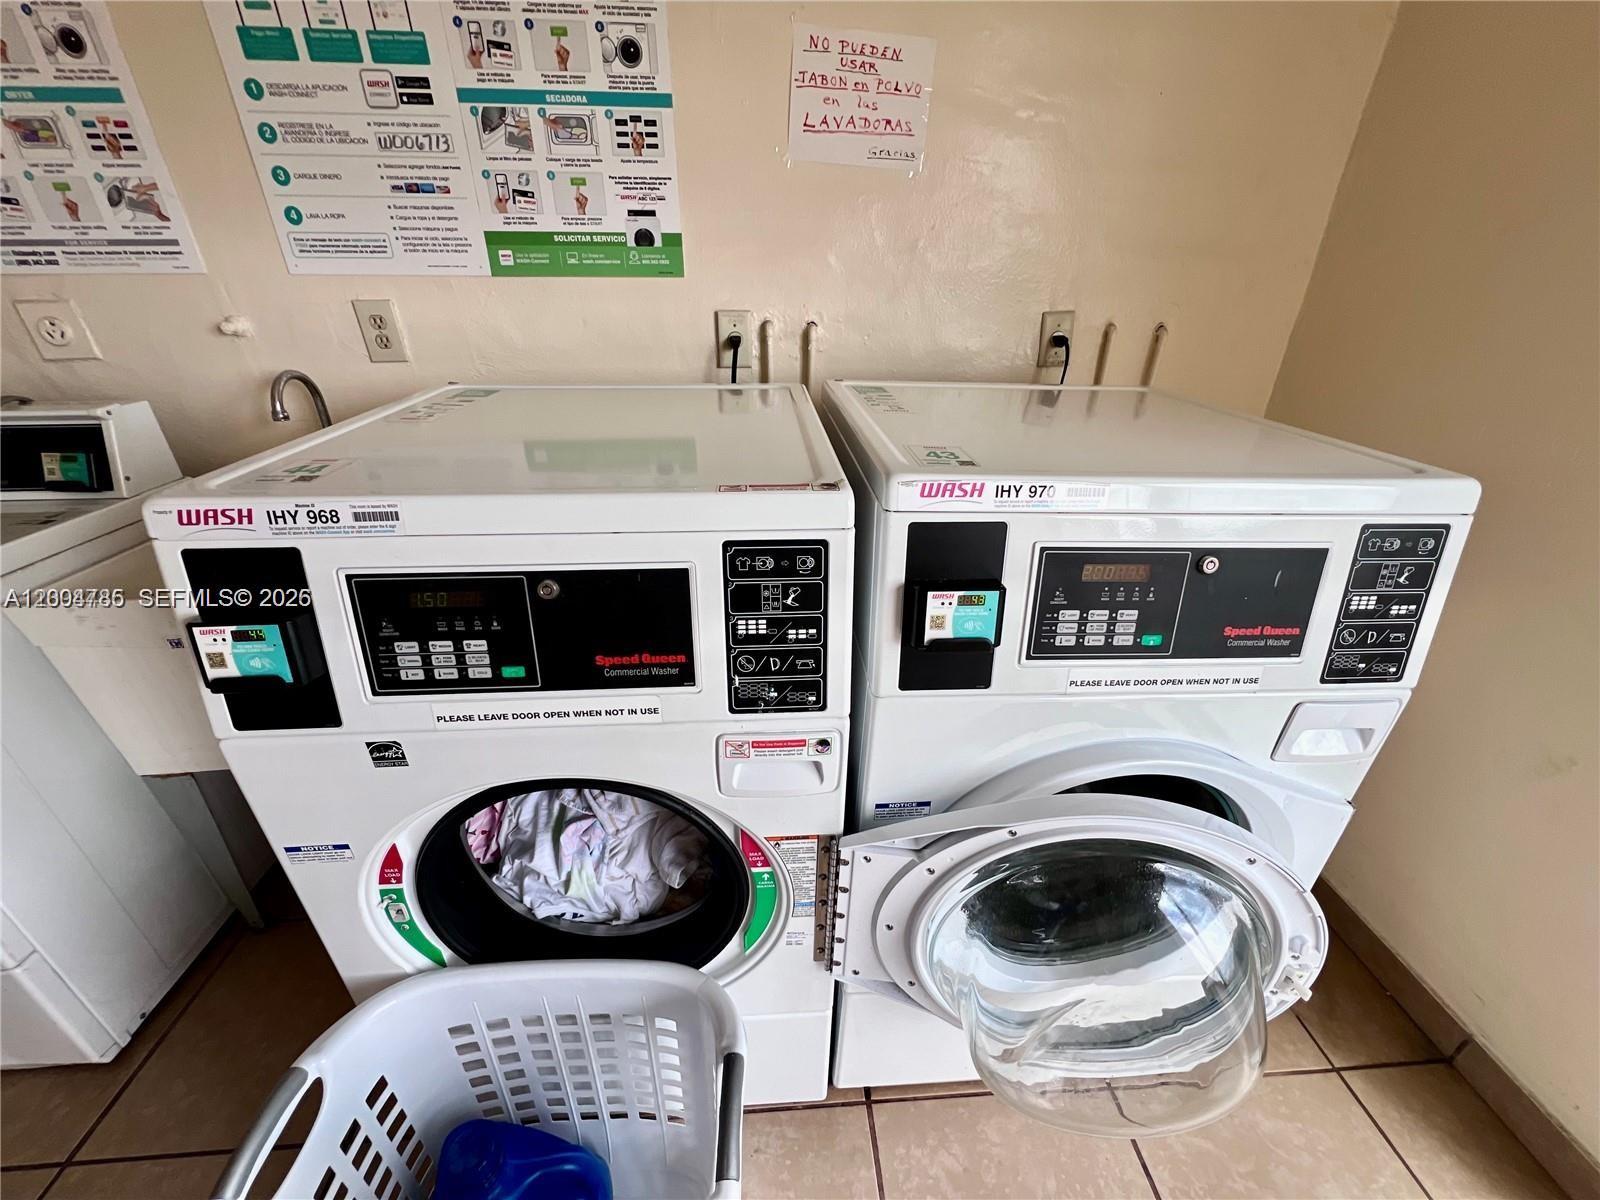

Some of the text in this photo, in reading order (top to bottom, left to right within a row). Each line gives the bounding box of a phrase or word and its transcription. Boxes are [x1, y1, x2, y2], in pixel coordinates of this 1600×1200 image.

[810, 34, 902, 60] NO PUEDEN
[840, 57, 879, 73] USAR
[366, 80, 390, 89] WASH
[795, 71, 922, 94] JABON en POLVO
[545, 93, 588, 104] SECADORA
[823, 96, 840, 107] en
[803, 112, 913, 133] LAVADORAS
[263, 126, 272, 139] 2
[277, 168, 286, 182] 3
[289, 209, 297, 220] 4
[553, 234, 626, 243] SOLICITAR SERVICIO
[919, 482, 986, 498] WASH
[995, 485, 1023, 499] IHY
[176, 508, 253, 526] WASH
[266, 510, 341, 525] IHY 968
[1223, 626, 1300, 637] Speed Queen
[1226, 638, 1291, 647] Commercial Washer
[595, 653, 686, 666] Speed Queen
[604, 666, 680, 677] Commercial Washer
[1068, 679, 1102, 687] PLEASE
[1104, 679, 1132, 687] LEAVE
[1160, 678, 1184, 686] OPEN
[1231, 677, 1241, 685] IN
[1242, 677, 1260, 685] USE
[436, 707, 660, 723] PLEASE LEAVE DOOR OPEN WHEN NOT IN USE
